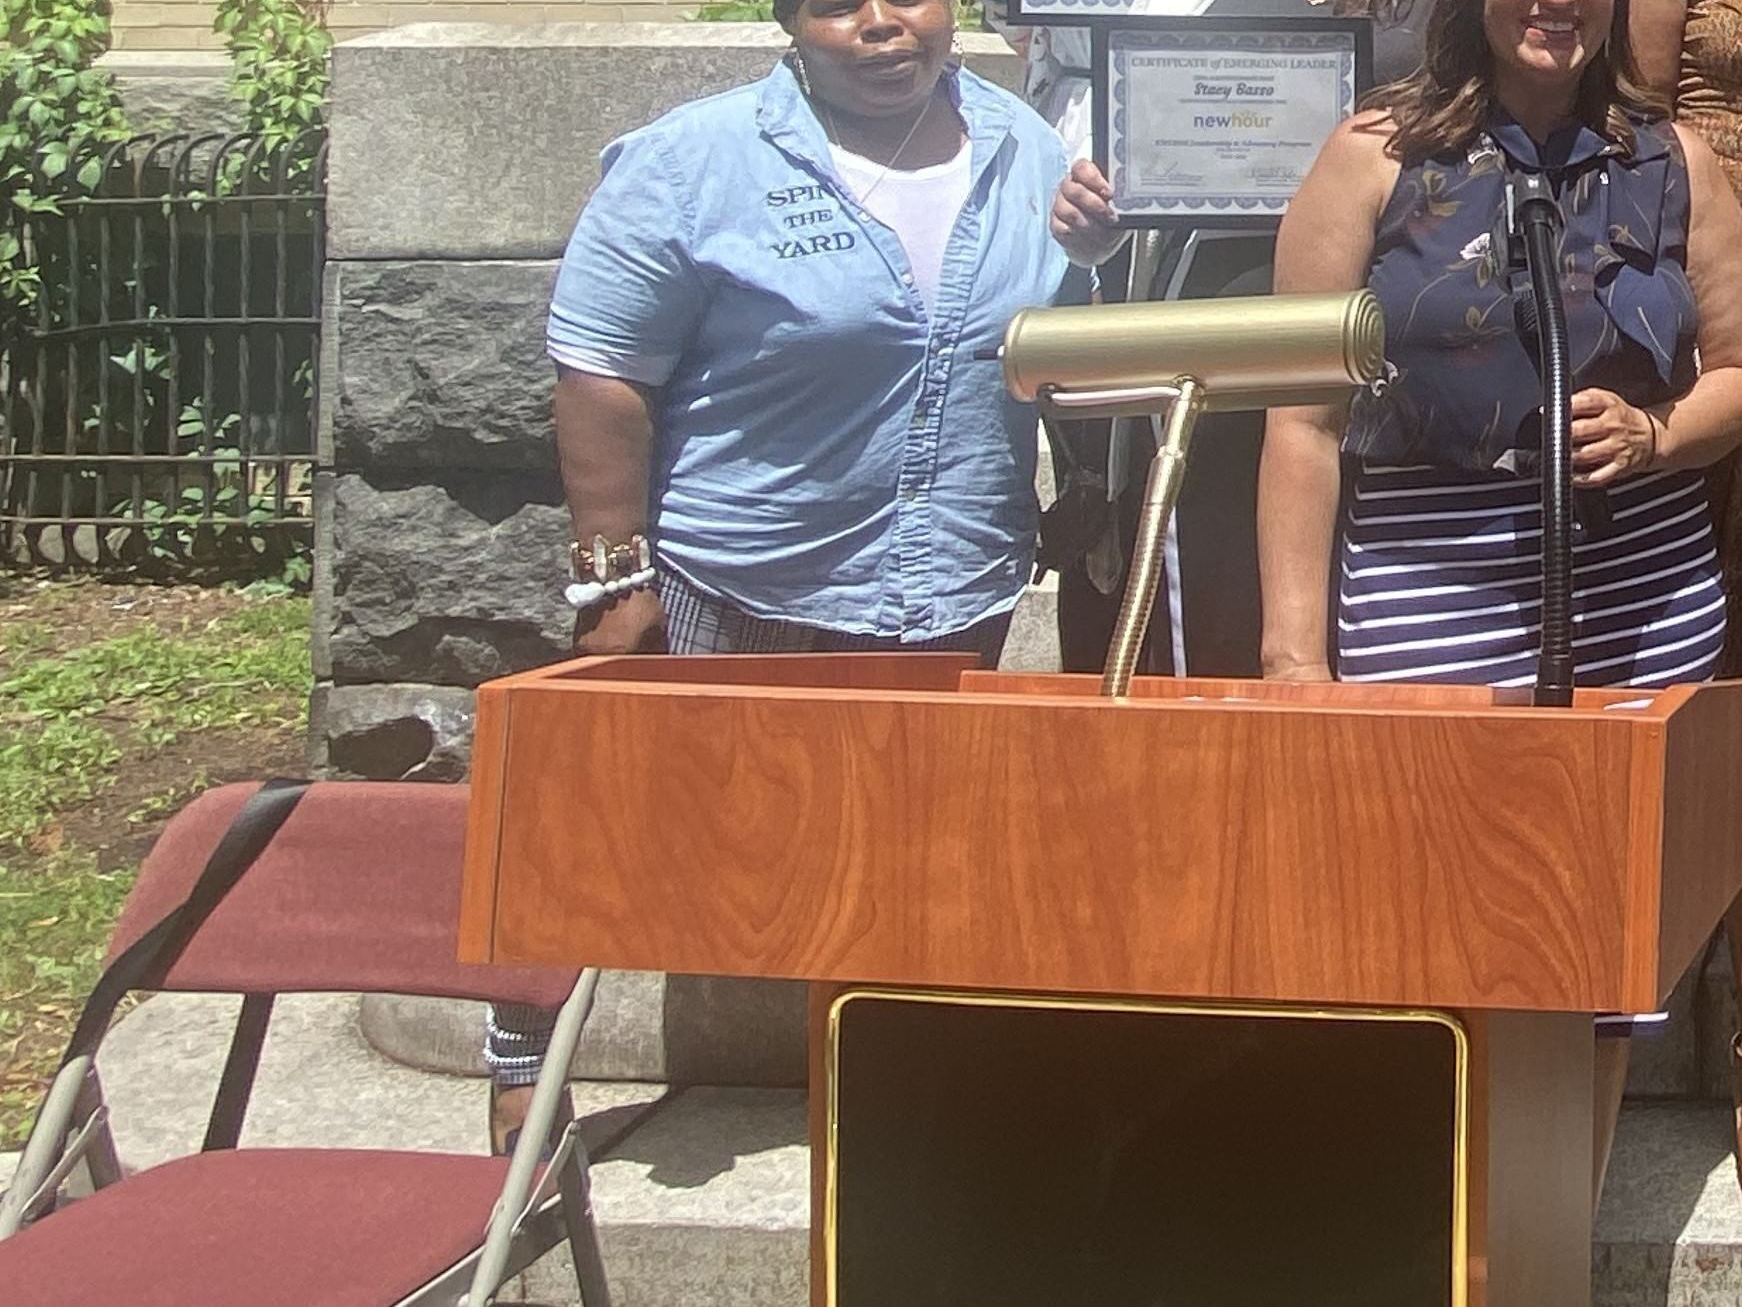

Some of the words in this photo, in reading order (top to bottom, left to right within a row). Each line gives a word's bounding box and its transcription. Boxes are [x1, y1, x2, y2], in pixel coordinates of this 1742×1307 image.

[1131, 57, 1209, 69] CERTIFICATE
[1210, 57, 1223, 71] of
[1223, 57, 1289, 69] EMERGING
[1290, 58, 1338, 70] LEADER
[1193, 83, 1231, 99] Stacy
[1236, 82, 1274, 96] Basso
[1193, 112, 1273, 128] newhour
[784, 209, 833, 229] THE
[768, 232, 855, 259] YARD
